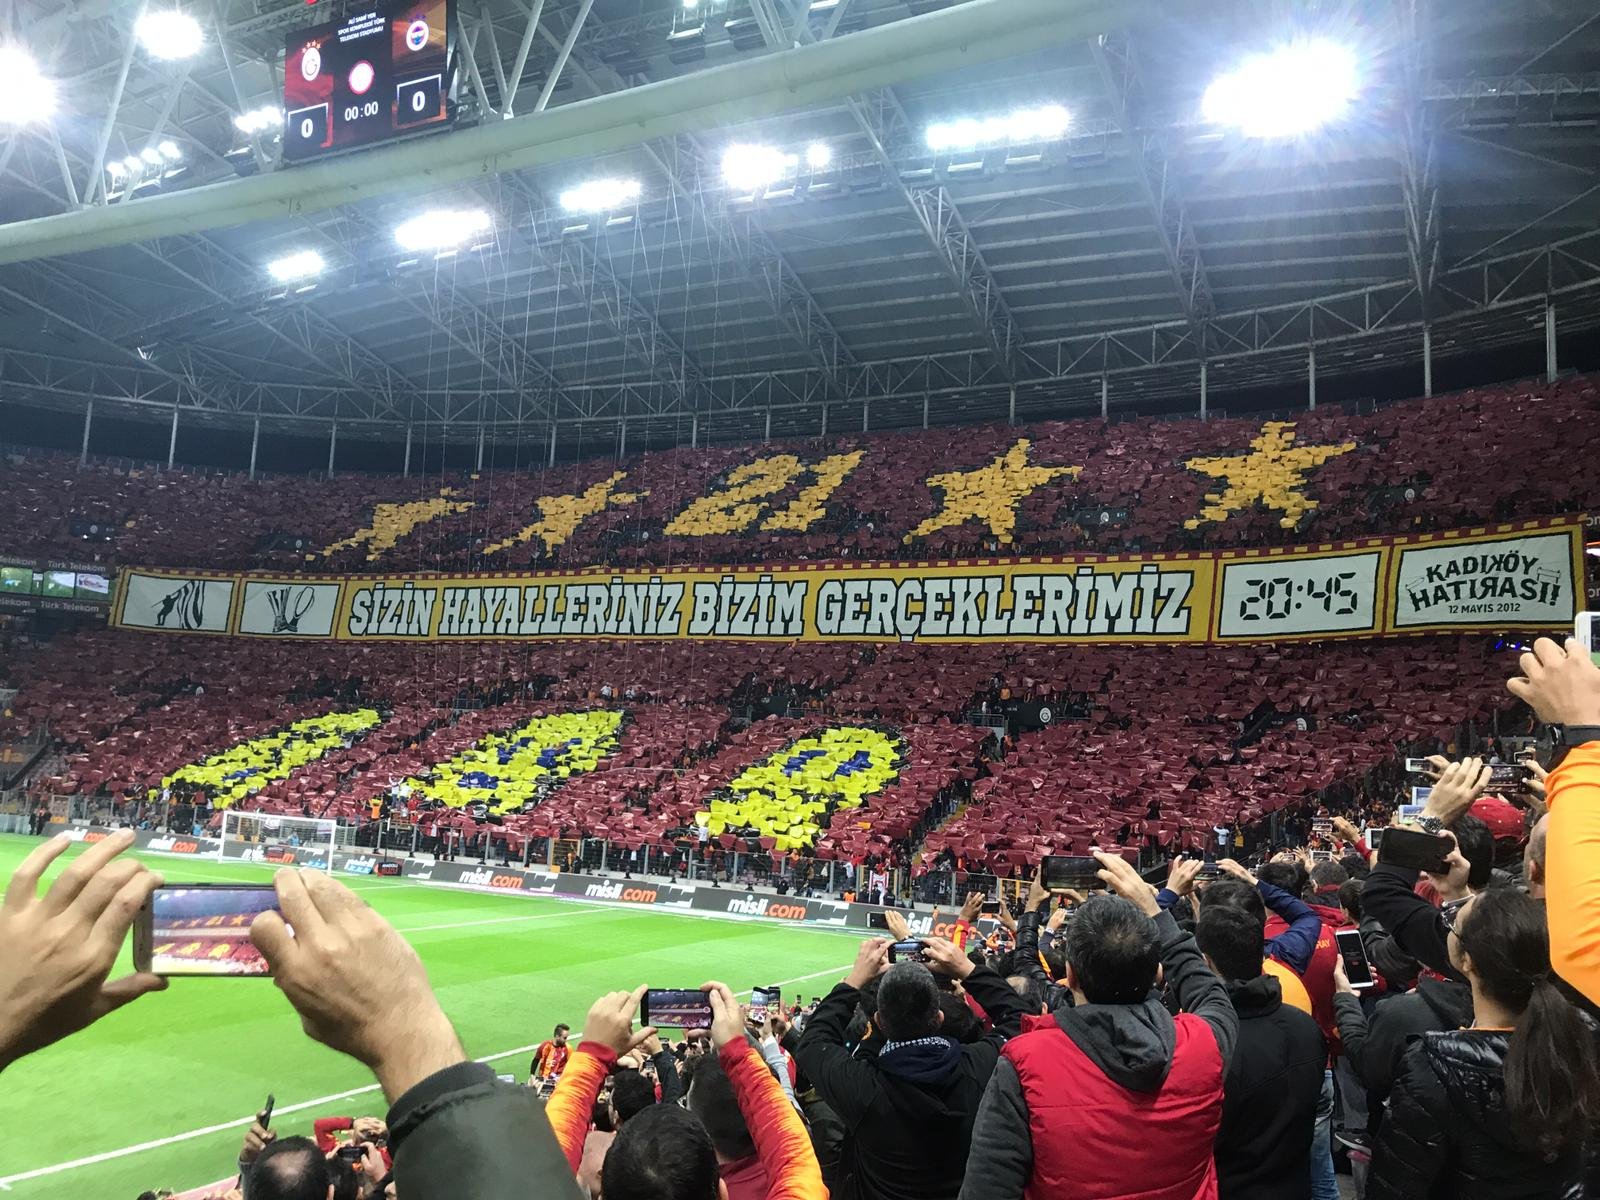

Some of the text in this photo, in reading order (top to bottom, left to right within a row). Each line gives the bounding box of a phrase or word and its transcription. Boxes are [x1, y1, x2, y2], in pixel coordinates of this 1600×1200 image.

[345, 101, 379, 121] 00:00
[412, 91, 425, 111] 0
[301, 118, 314, 138] 0
[348, 564, 1195, 642] SİZİN HAYALLERİNİZ BİZİM GERÇEKLERİMİZ
[1240, 572, 1357, 620] 20:45
[1461, 604, 1494, 613] MAYIS
[1496, 603, 1521, 612] 2012
[585, 879, 657, 902] misli.com
[727, 894, 806, 920] misli.com
